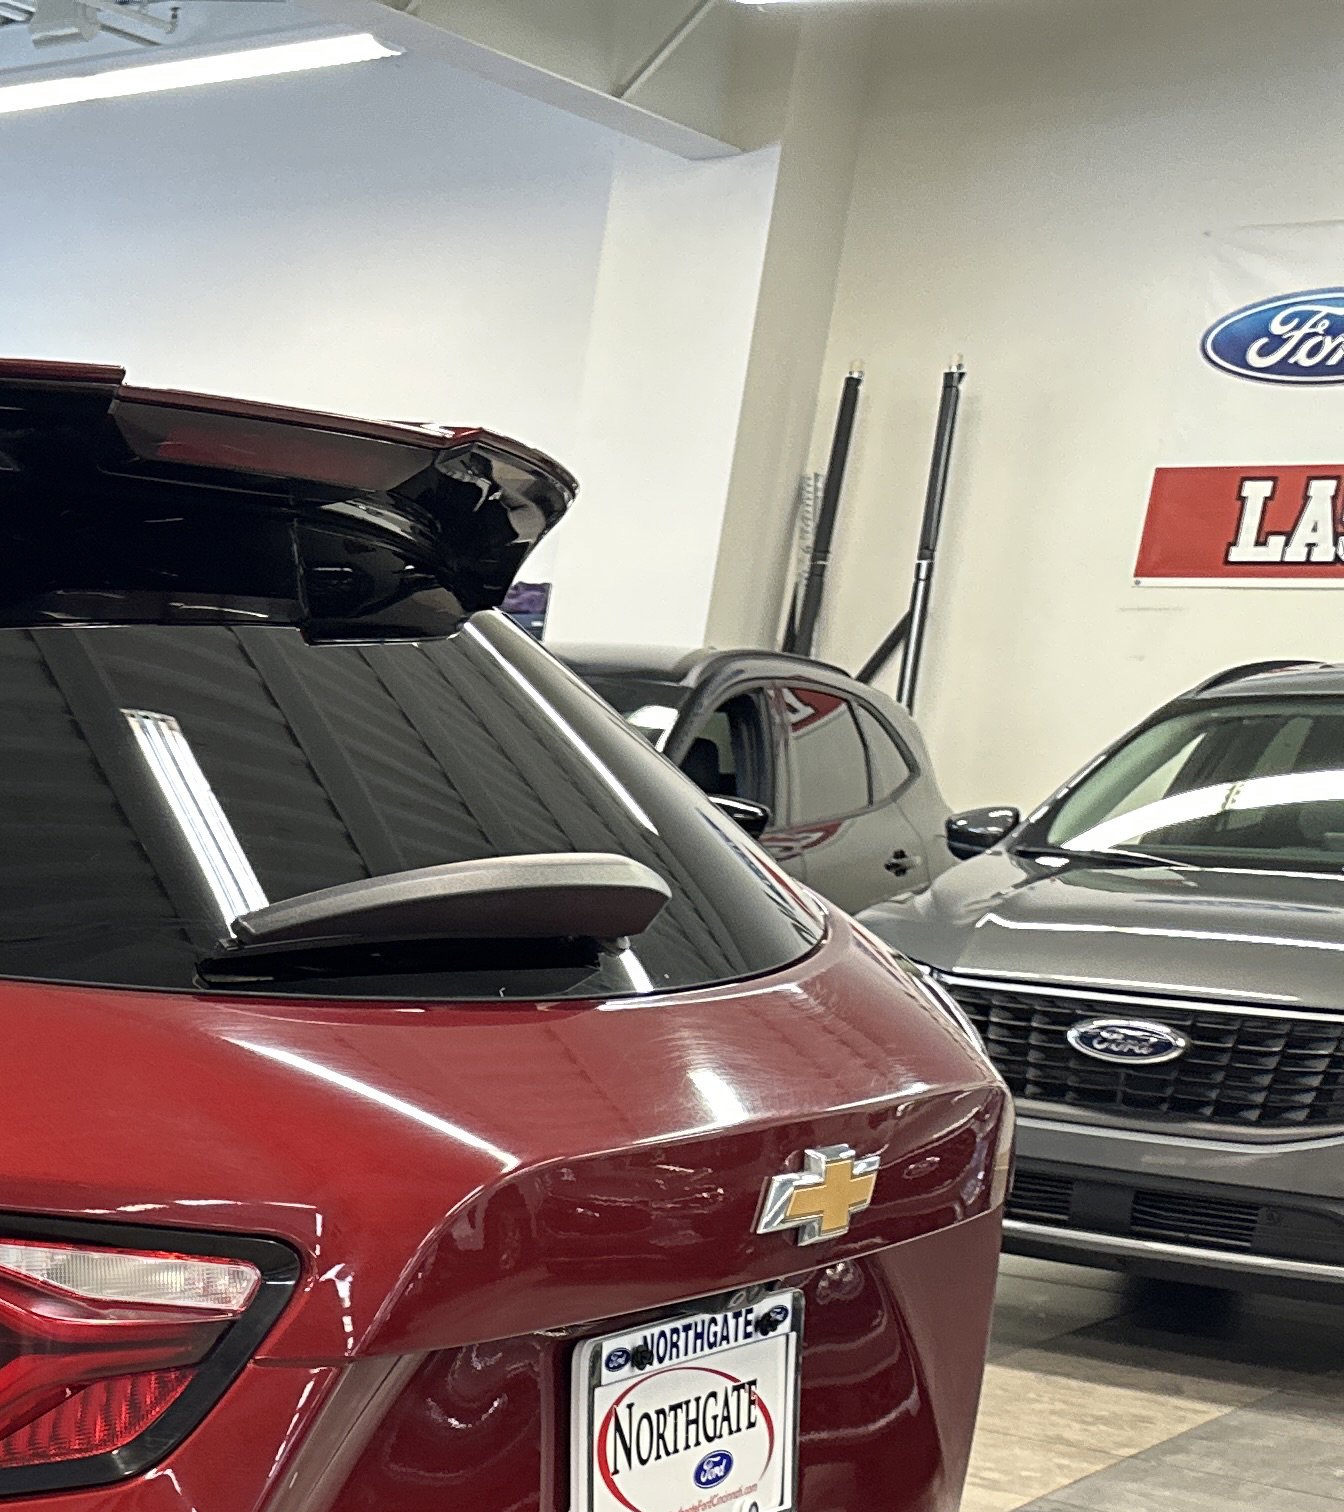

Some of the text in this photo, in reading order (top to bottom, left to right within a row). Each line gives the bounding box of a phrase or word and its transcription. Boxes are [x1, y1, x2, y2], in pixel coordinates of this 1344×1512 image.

[1245, 304, 1344, 369] For
[1225, 478, 1344, 564] LA
[1092, 1027, 1159, 1055] Ford
[643, 1307, 755, 1366] NORTHGATE
[611, 1378, 759, 1477] NORTHGATE
[699, 1452, 729, 1483] Ford
